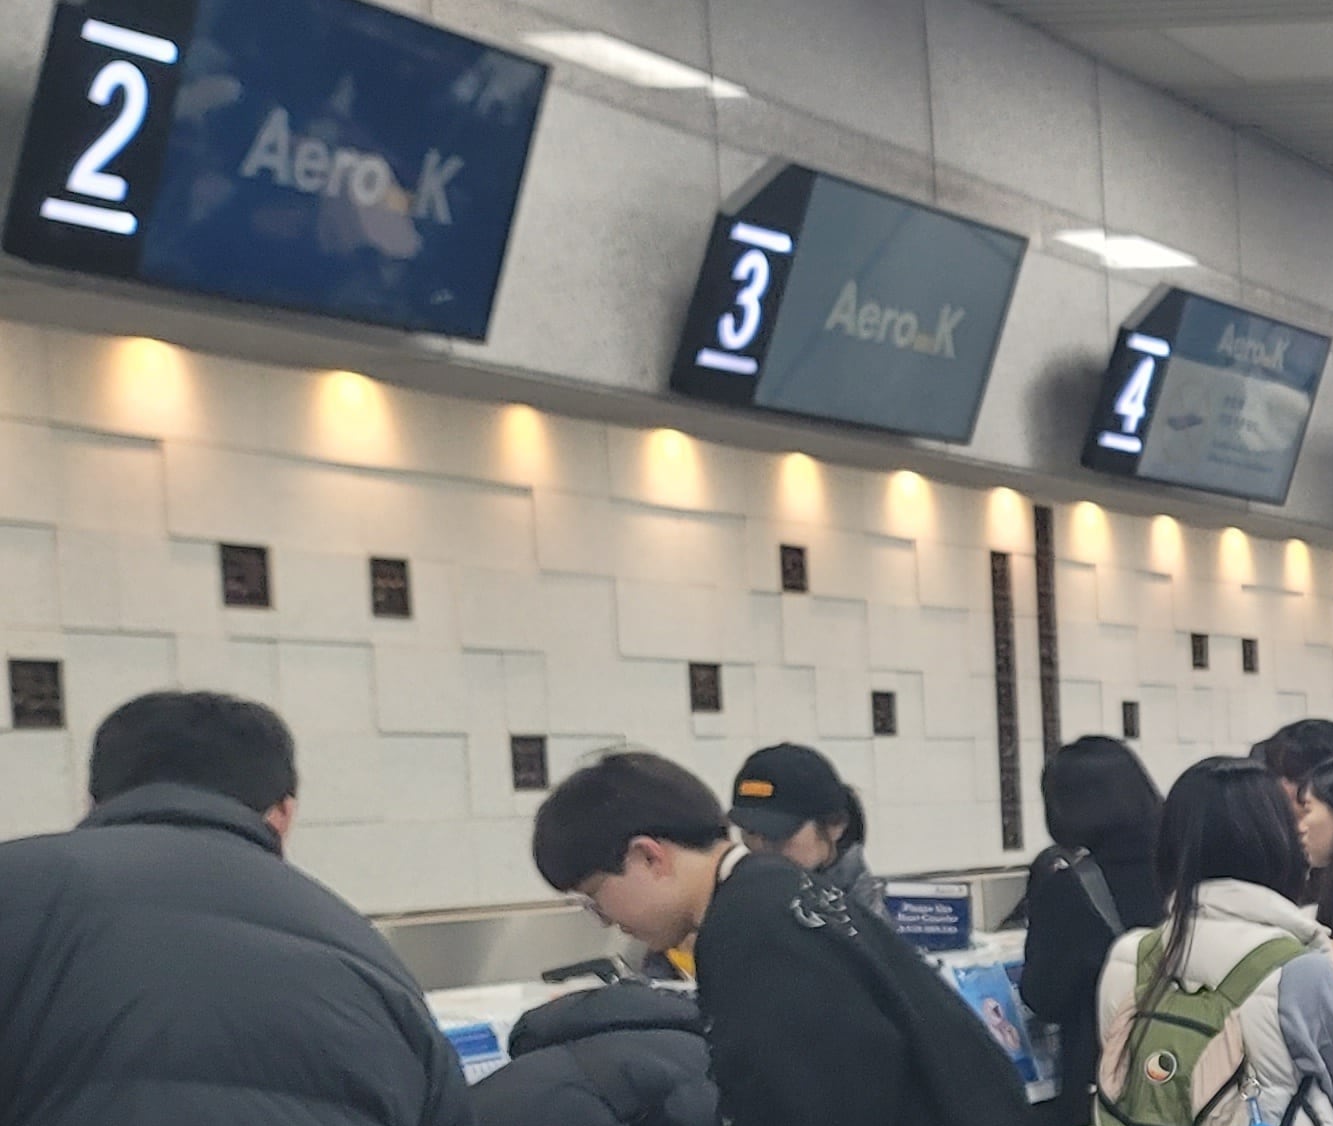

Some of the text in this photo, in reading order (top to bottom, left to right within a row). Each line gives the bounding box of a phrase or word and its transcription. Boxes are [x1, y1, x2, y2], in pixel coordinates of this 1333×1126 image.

[66, 60, 150, 201] 2
[241, 106, 464, 225] Aero K
[717, 248, 770, 350] 3
[825, 279, 965, 359] Aero K
[1113, 355, 1155, 434] 4
